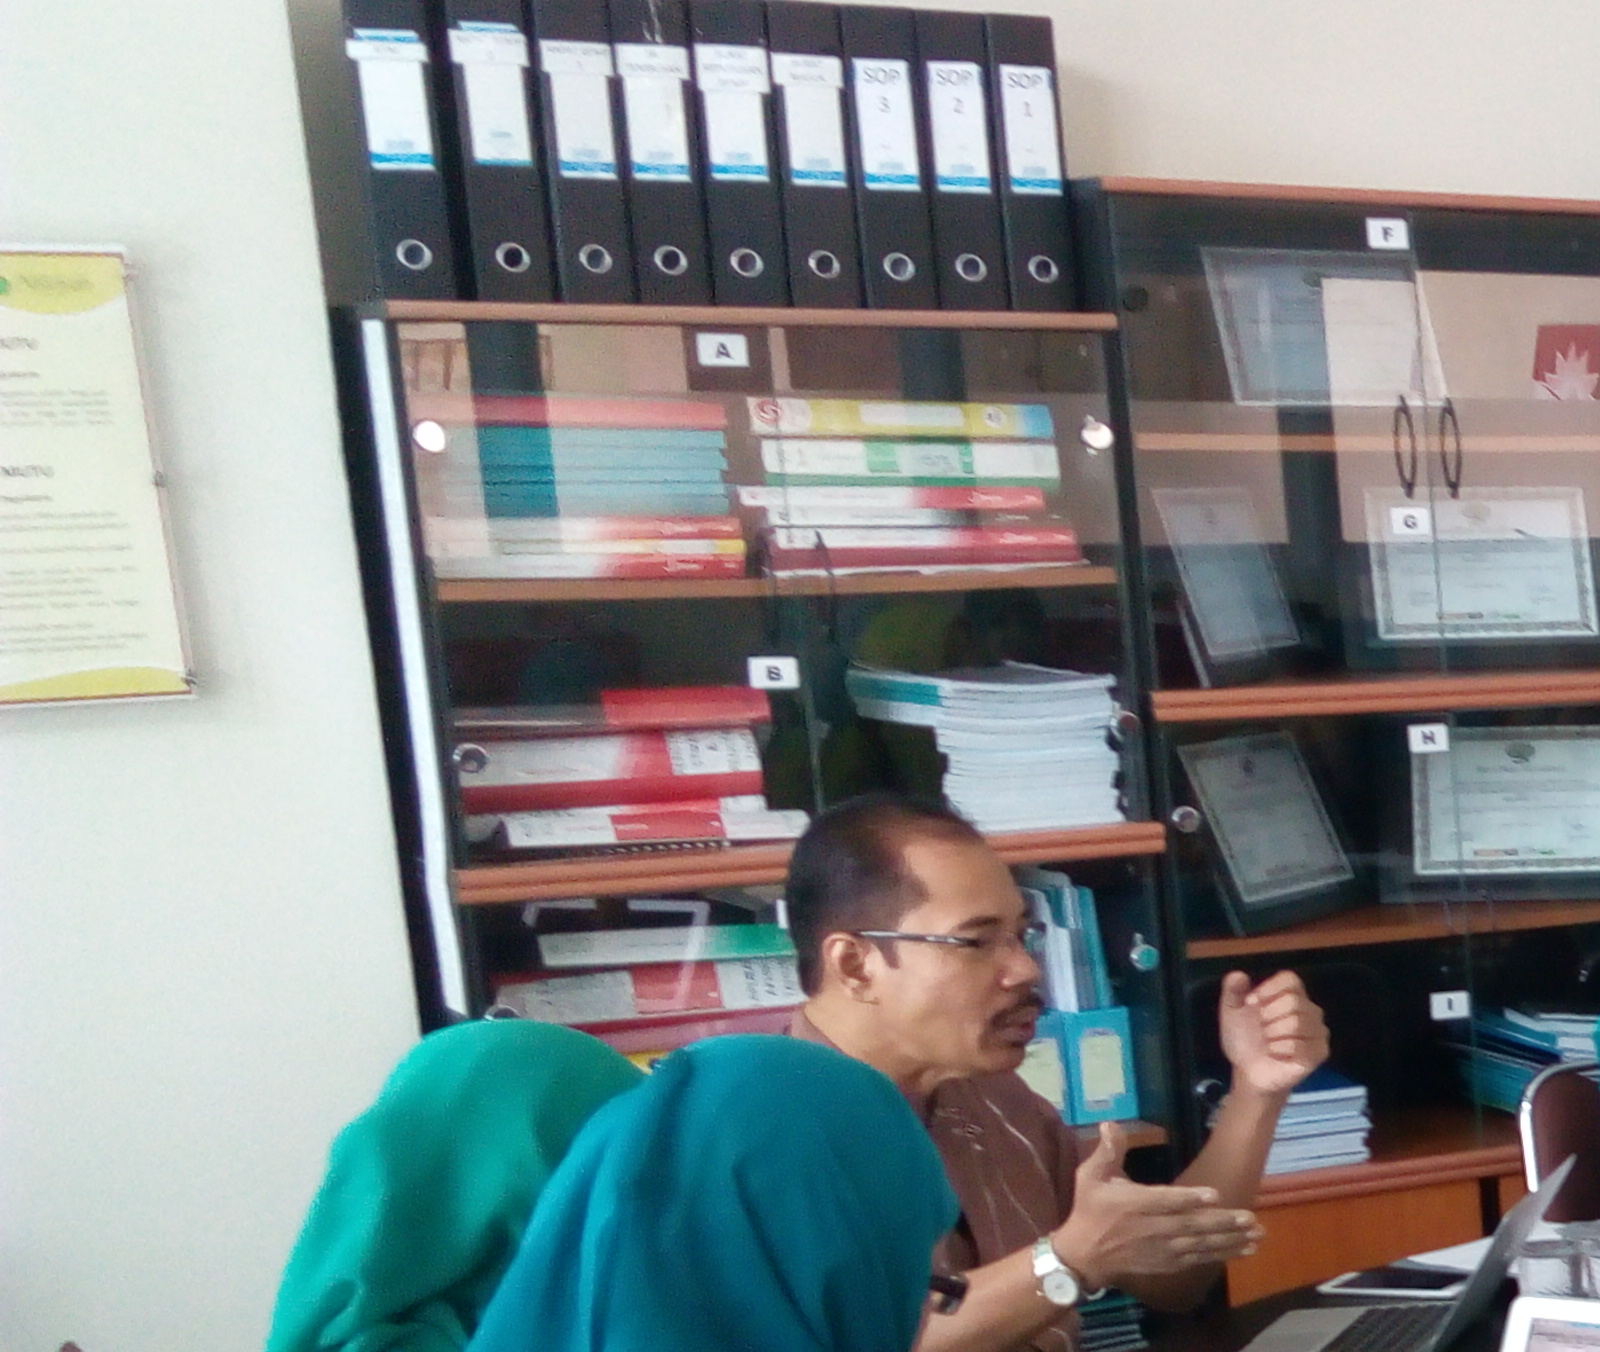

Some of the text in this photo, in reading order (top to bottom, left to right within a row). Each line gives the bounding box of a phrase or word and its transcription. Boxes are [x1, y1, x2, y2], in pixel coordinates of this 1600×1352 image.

[863, 67, 900, 85] SOP
[936, 68, 973, 86] SOP
[1007, 72, 1043, 89] SOP
[878, 96, 890, 113] 3
[953, 97, 964, 114] 2
[1024, 101, 1032, 117] 1
[1381, 226, 1394, 242] F
[715, 342, 734, 359] A
[1403, 515, 1417, 530] G
[766, 666, 783, 682] B
